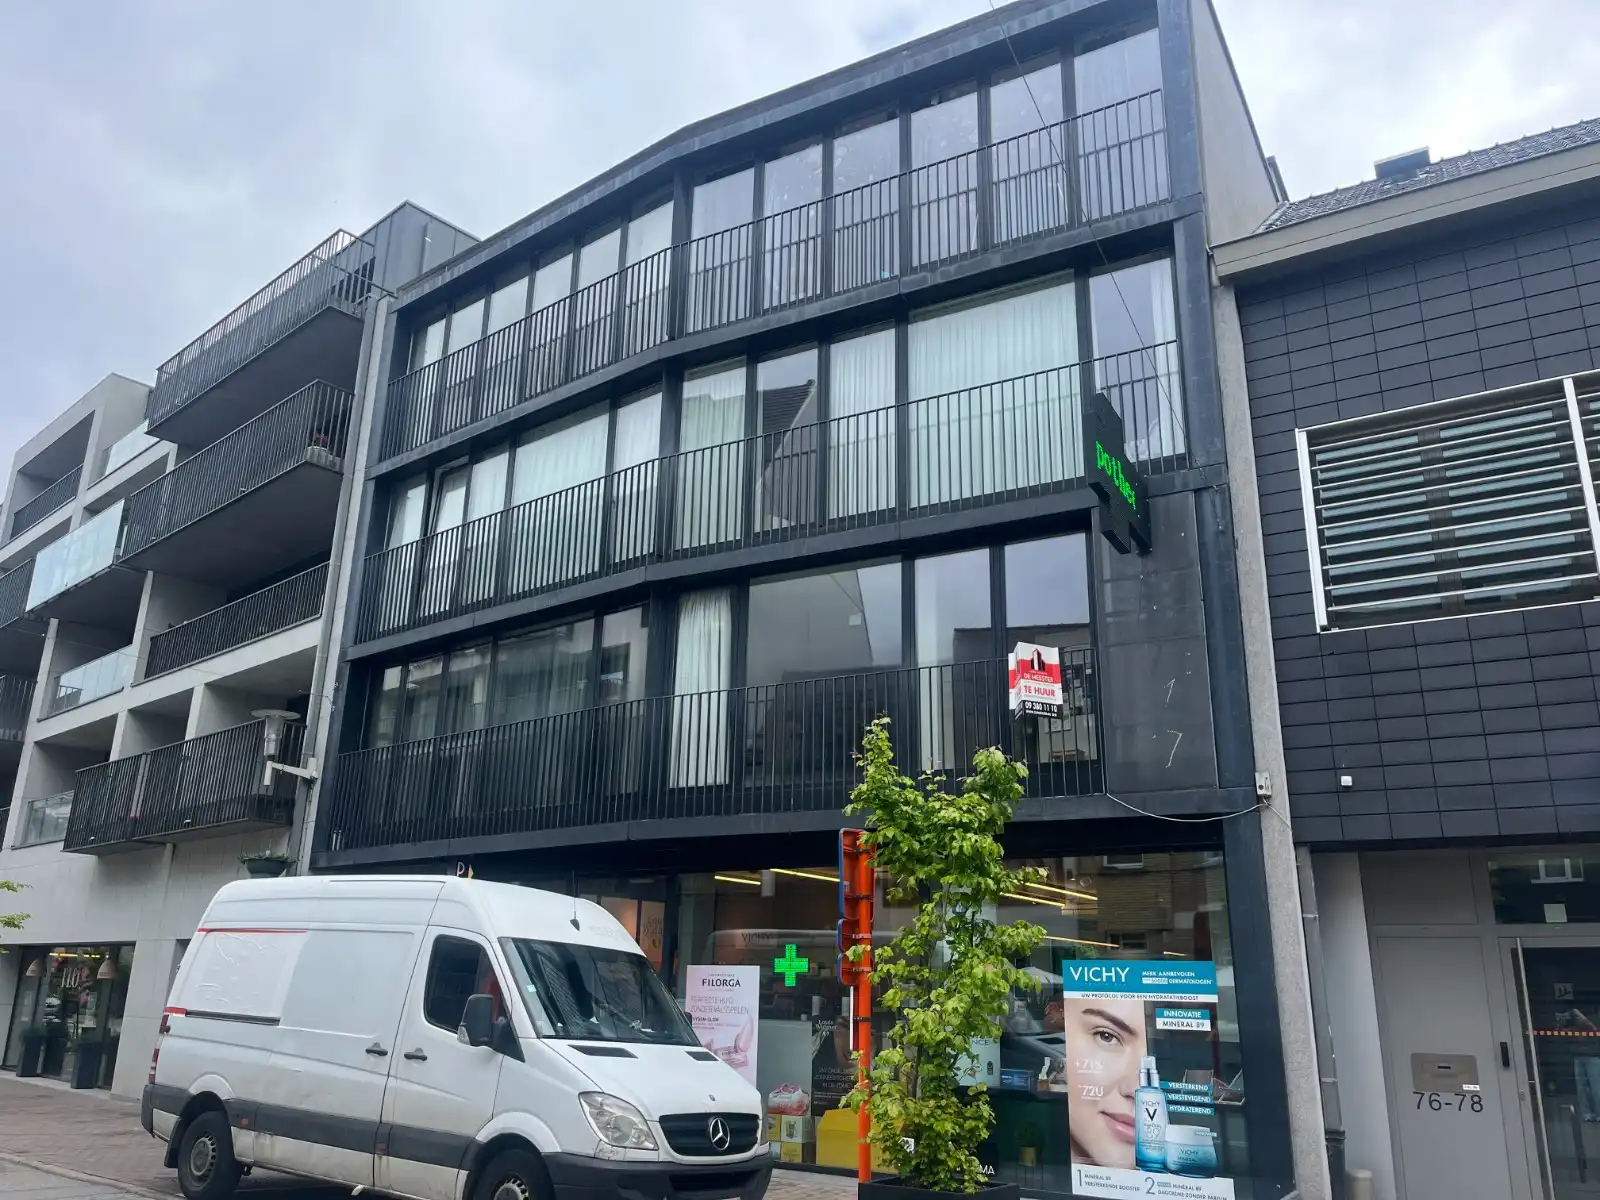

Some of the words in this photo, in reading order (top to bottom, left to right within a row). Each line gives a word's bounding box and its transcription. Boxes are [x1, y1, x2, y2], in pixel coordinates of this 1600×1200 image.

[1024, 685, 1032, 693] TE
[1034, 687, 1055, 696] HUUR
[1025, 701, 1031, 709] 09
[1069, 966, 1130, 982] VICHY
[702, 978, 741, 987] FILORGA
[1164, 1010, 1201, 1018] INNOVATIE
[1169, 1083, 1208, 1091] VERSTERKEND
[1168, 1094, 1211, 1102] VERSTEVIGEND
[1413, 1091, 1483, 1112] 76-78
[1169, 1105, 1211, 1114] HYDRATEREND
[1077, 1169, 1082, 1187] 1
[1144, 1177, 1156, 1195] 2
